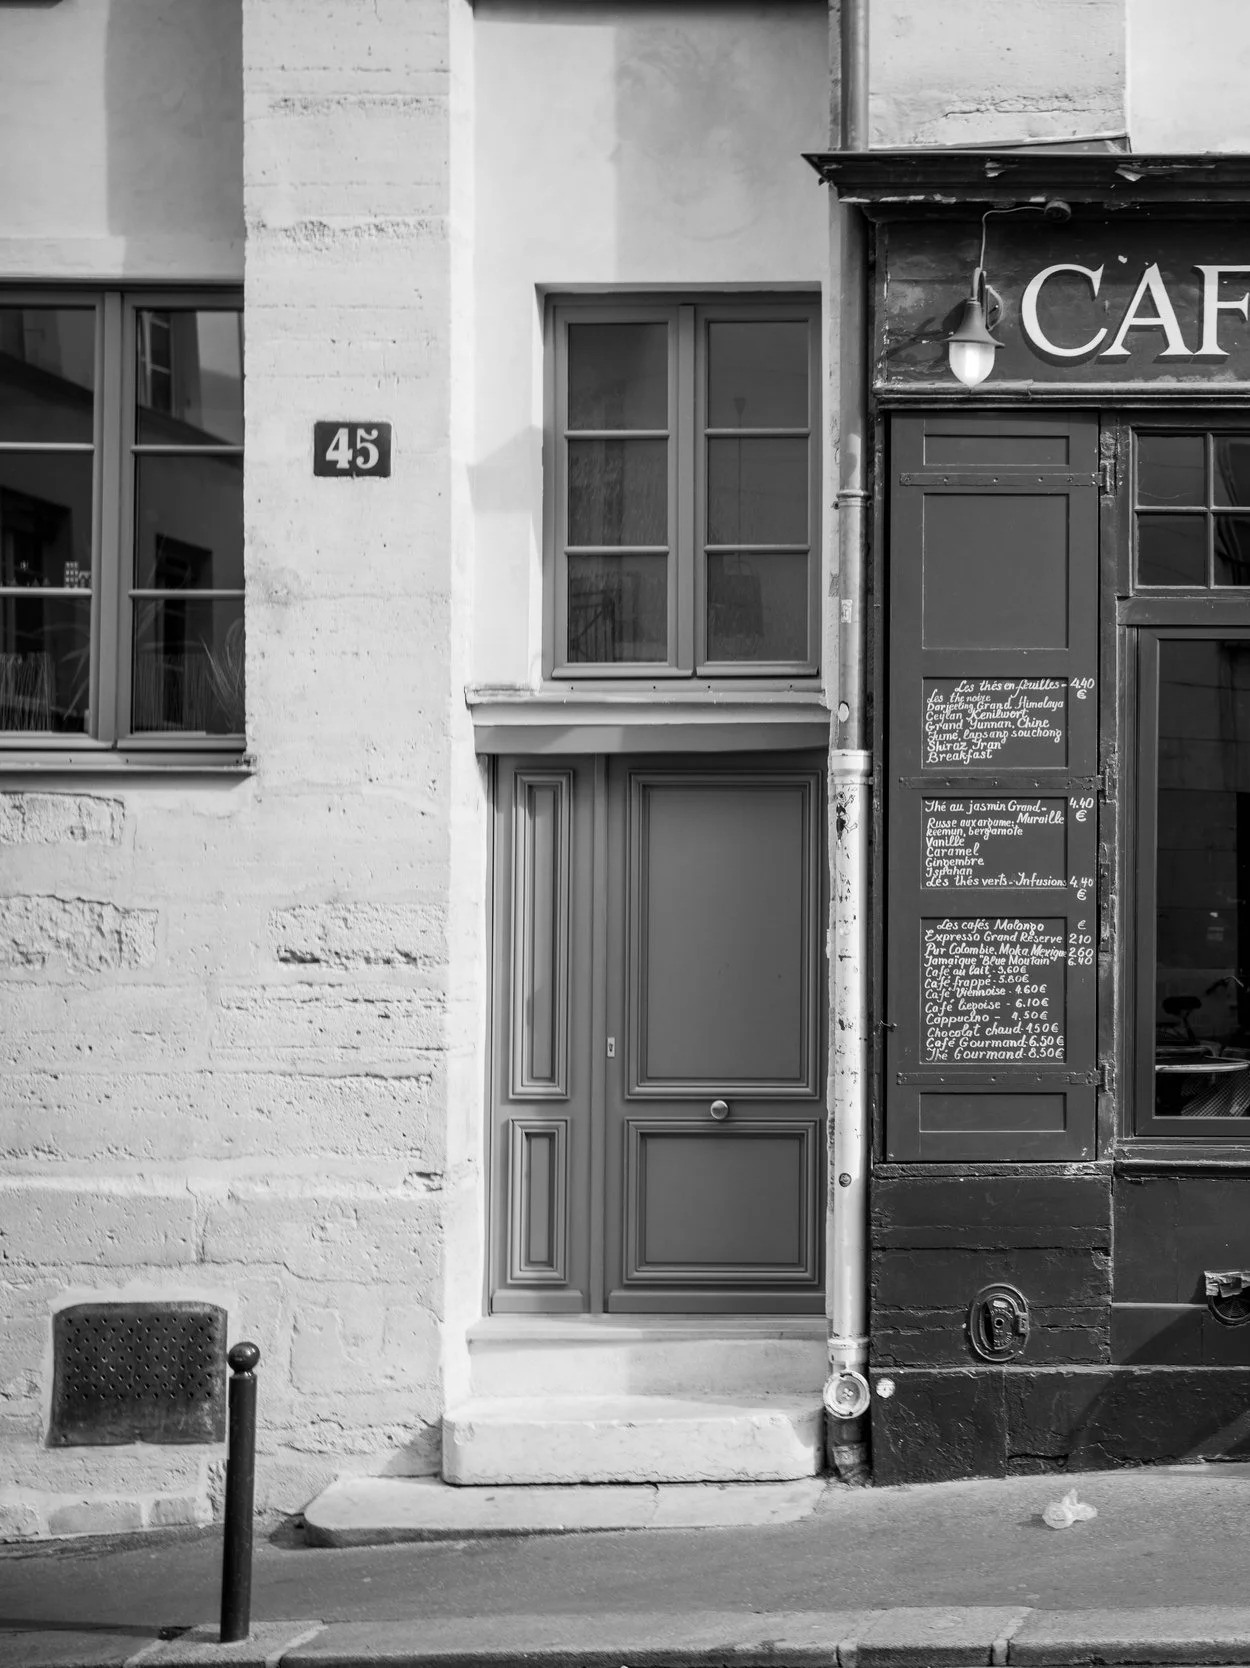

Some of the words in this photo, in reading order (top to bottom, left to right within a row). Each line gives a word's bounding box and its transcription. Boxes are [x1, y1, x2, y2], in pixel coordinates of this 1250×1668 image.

[326, 427, 379, 469] 45
[954, 680, 974, 693] Les
[979, 680, 1002, 691] thés
[1003, 682, 1015, 691] en
[926, 689, 944, 703] Les
[1015, 696, 1064, 711] Himalaya
[925, 719, 963, 731] Grand
[1017, 717, 1050, 728] Chine
[926, 741, 968, 752] Shiraz
[926, 749, 993, 764] Breakfast
[924, 800, 946, 812] Thé
[949, 803, 964, 811] au
[966, 801, 1006, 814] jasmin
[927, 817, 957, 828] Russe
[968, 825, 1023, 840] bergamote
[925, 835, 965, 846] Vanille
[926, 842, 980, 857] Caramel
[925, 856, 984, 869] Gingembre
[926, 875, 949, 887] Les
[954, 874, 979, 886] thés
[981, 874, 1007, 886] verts
[936, 919, 959, 930] Les
[961, 919, 989, 934] cafés
[994, 919, 1045, 936] Malongo
[924, 929, 980, 945] Expresso
[983, 931, 1016, 942] Grand
[924, 942, 947, 956] Pur
[925, 966, 950, 980] Café
[969, 965, 989, 976] lait
[924, 976, 950, 991] Café
[952, 975, 991, 991] frappé
[925, 987, 950, 1002] Café
[956, 987, 1006, 997] Viennoise
[925, 999, 954, 1016] Café
[926, 1013, 989, 1027] Cappucino
[927, 1023, 981, 1038] Chocolat
[926, 1036, 955, 1049] Café
[926, 1048, 948, 1061] Thé
